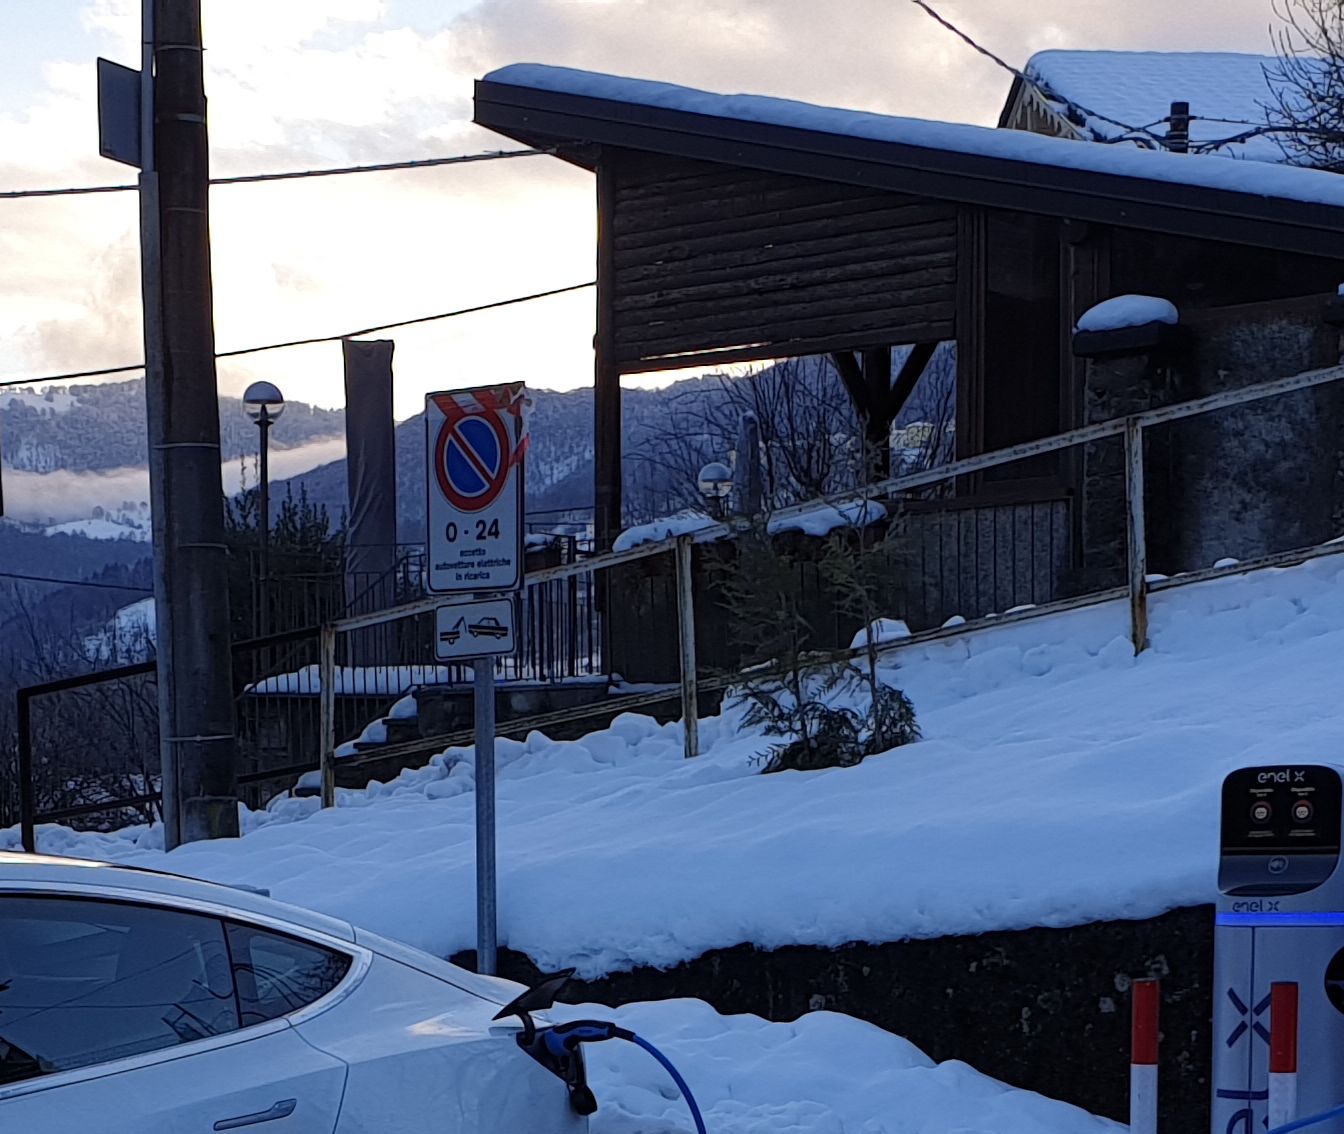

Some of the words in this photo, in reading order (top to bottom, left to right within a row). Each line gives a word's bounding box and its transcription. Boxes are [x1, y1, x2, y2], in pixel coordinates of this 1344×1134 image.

[445, 521, 458, 543] 0
[475, 517, 500, 541] 24
[477, 557, 511, 567] elettriche
[463, 571, 490, 581] ricarica
[1257, 768, 1291, 784] enel
[1231, 899, 1263, 913] enel
